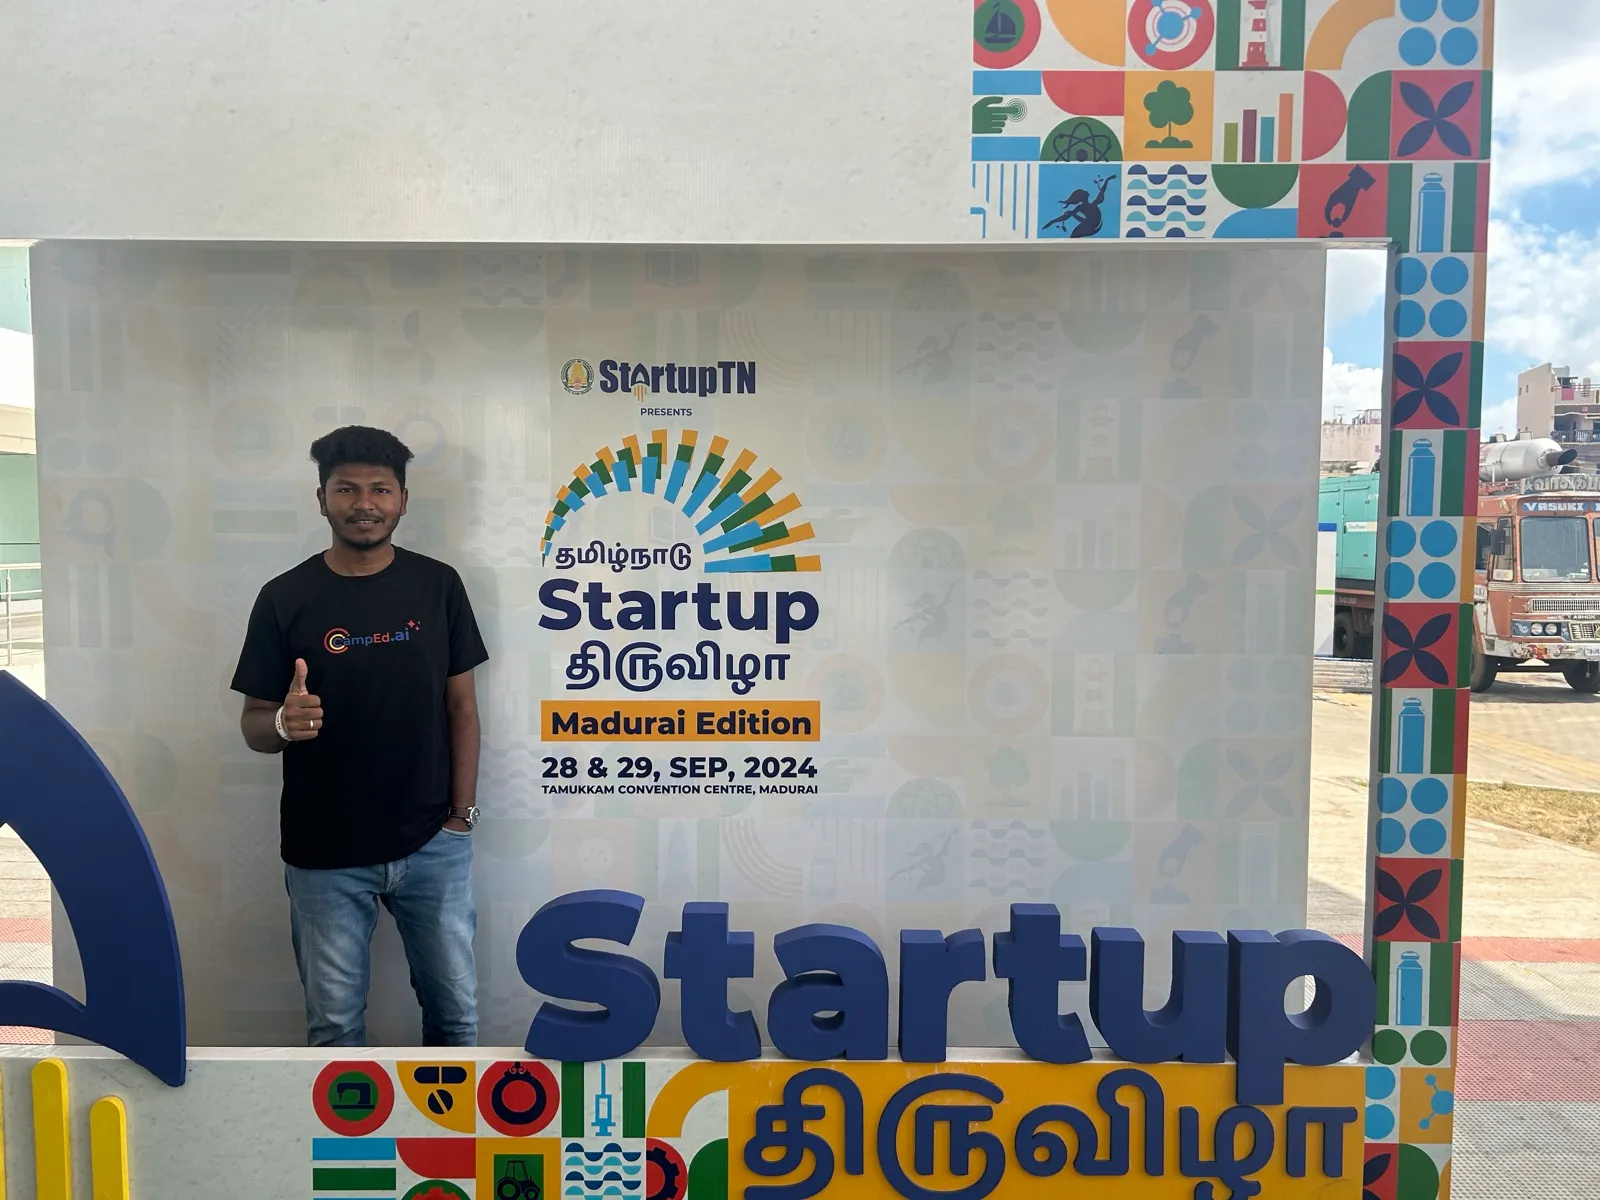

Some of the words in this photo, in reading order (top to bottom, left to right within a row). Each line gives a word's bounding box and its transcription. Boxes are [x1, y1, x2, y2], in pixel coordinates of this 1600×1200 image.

[640, 407, 693, 417] PRESENTS
[1523, 502, 1584, 511] VASUKI
[555, 540, 692, 573] தமிழ்நாடு
[538, 578, 820, 644] Startup
[565, 639, 791, 696] திருவிழா
[551, 708, 686, 736] Madurai
[696, 708, 812, 736] Edition
[541, 756, 578, 779] 28
[587, 756, 609, 779] &
[616, 756, 661, 782] 29,
[669, 756, 736, 782] SEP,
[743, 756, 818, 779] 2024
[541, 784, 615, 795] TAMUKKAM
[617, 784, 701, 795] CONVENTION
[703, 784, 756, 795] CENTRE,
[759, 784, 818, 795] MADURAI
[515, 889, 1377, 1106] Startup
[743, 1067, 1359, 1200] திருவிழா
